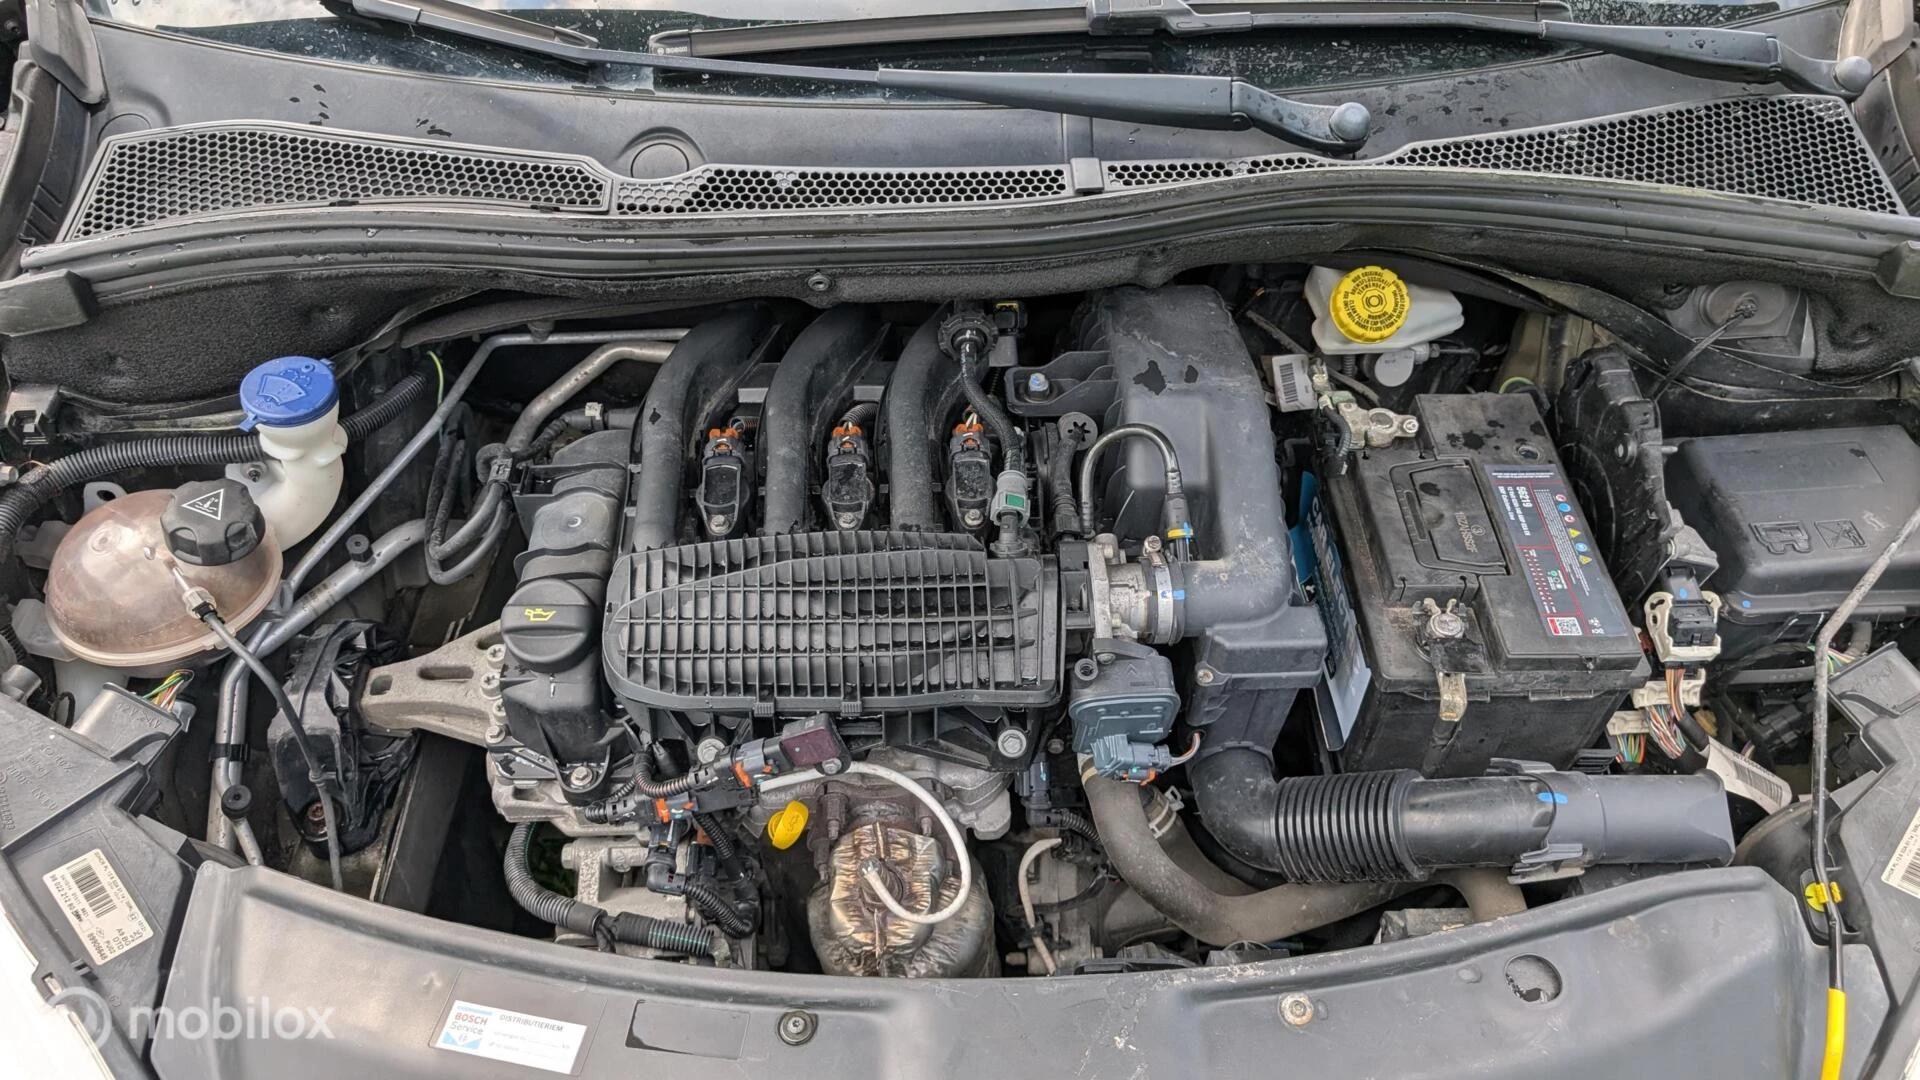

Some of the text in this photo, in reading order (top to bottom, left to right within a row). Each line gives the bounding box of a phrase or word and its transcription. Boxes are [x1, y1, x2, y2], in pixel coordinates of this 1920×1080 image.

[1516, 486, 1532, 507] 56219
[454, 1012, 488, 1026] BOSCH
[449, 1021, 484, 1035] Service
